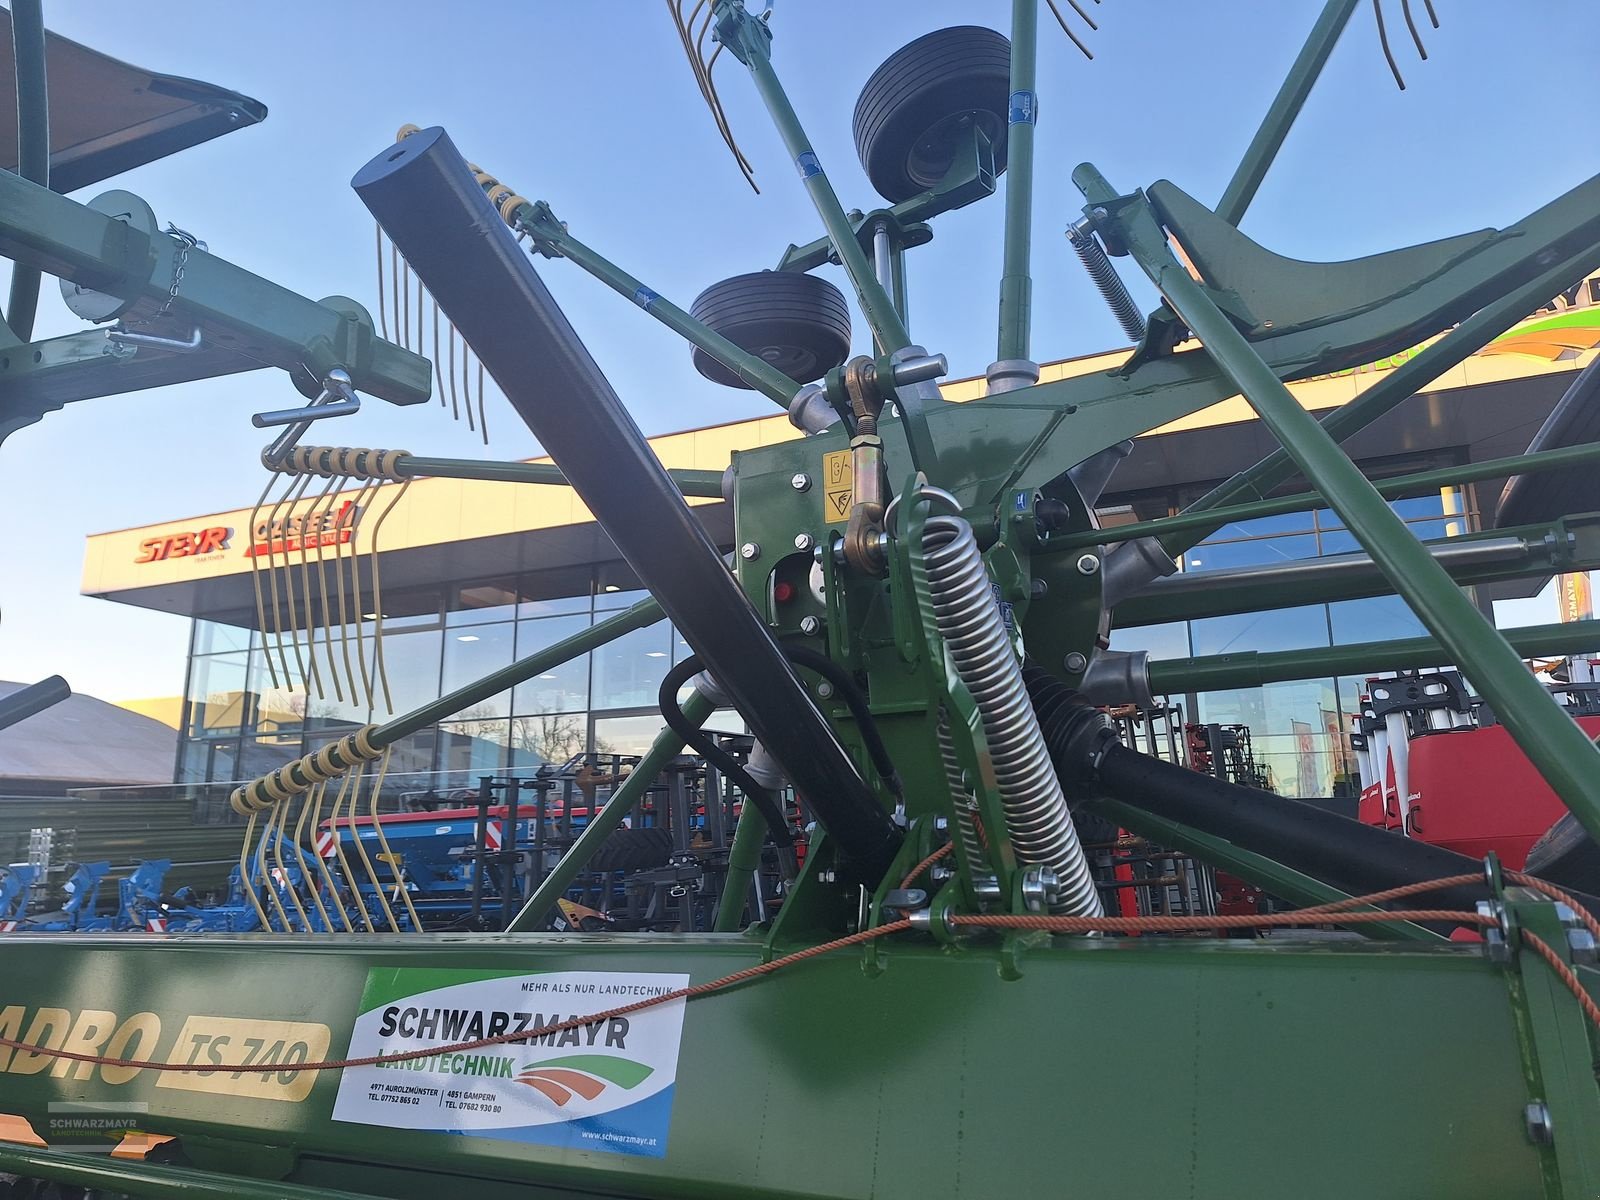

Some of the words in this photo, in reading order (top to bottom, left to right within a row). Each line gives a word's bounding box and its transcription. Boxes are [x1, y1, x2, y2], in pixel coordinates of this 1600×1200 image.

[134, 527, 227, 563] STEYR
[521, 982, 548, 992] MEHR
[552, 984, 571, 993] ALS
[574, 985, 596, 994] NUR
[599, 984, 673, 996] LANDTECHNIK
[378, 1006, 630, 1050] SCHWARZMAYR
[183, 1033, 231, 1078] TS
[231, 1038, 308, 1085] 740
[375, 1047, 516, 1079] LANDTECHNIK
[370, 1083, 385, 1092] 4971
[385, 1084, 438, 1097] AUROLZMÜNSTER
[447, 1090, 462, 1099] 4851
[463, 1091, 496, 1102] GAMPERN
[368, 1093, 380, 1101] TEL.
[381, 1094, 399, 1103] 07752
[399, 1096, 411, 1104] 865
[411, 1097, 420, 1105] 02
[445, 1101, 457, 1109] TEL.
[458, 1102, 479, 1111] 07682
[480, 1104, 492, 1112] 930
[492, 1105, 502, 1114] 80
[581, 1131, 657, 1146] www.schwarzmayr.at
